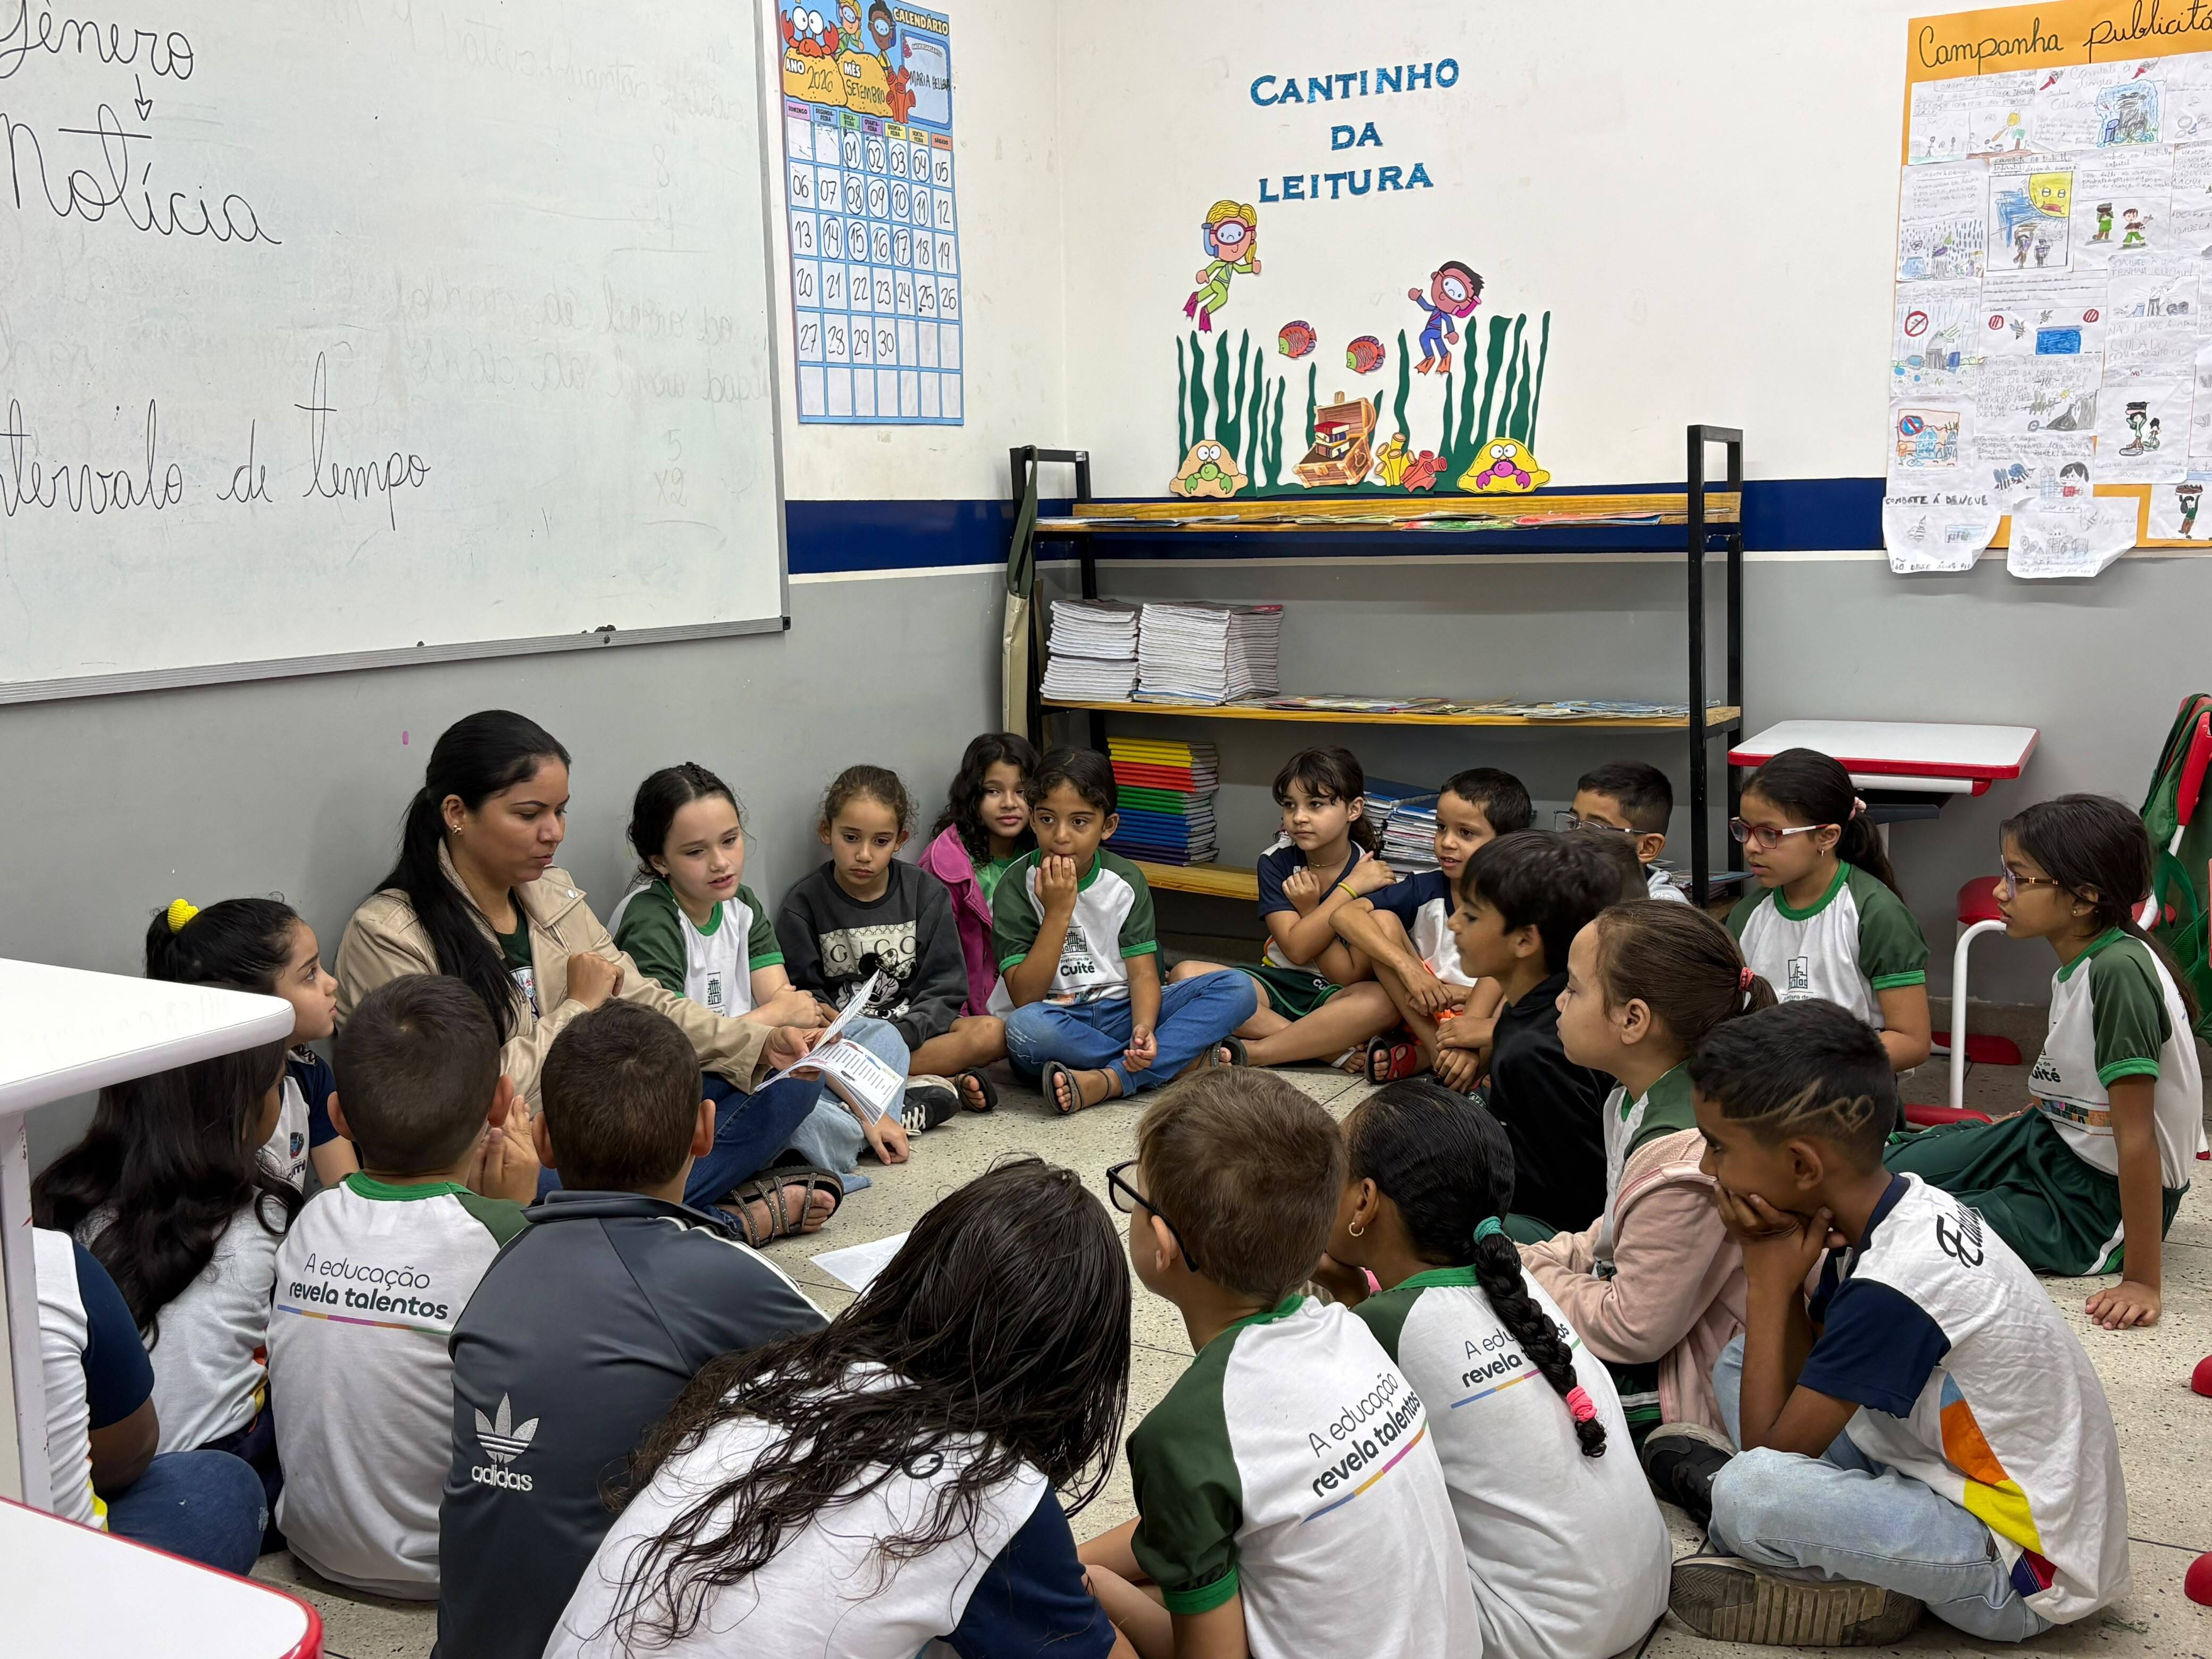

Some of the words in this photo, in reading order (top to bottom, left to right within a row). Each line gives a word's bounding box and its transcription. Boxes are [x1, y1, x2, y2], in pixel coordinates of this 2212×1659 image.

[893, 7, 949, 36] CALENDÁRIO
[785, 56, 805, 74] ANO
[1918, 18, 2064, 74] Campanha
[843, 61, 861, 78] MÊS
[1251, 58, 1459, 106] CANTINHO
[845, 79, 885, 104] SETEMBRO
[1331, 122, 1384, 150] DA
[0, 104, 282, 244] Notícia
[845, 141, 857, 164] 01
[868, 147, 883, 169] 02
[891, 151, 904, 174] 03
[914, 154, 927, 178] 04
[935, 162, 949, 182] 05
[793, 175, 809, 198] 06
[820, 180, 837, 205] 07
[847, 185, 862, 210] 08
[870, 186, 884, 215] 09
[894, 188, 906, 211] 10
[916, 197, 926, 221] 11
[937, 199, 950, 224] 12
[1259, 163, 1434, 203] LEITURA
[795, 221, 812, 249] 13
[824, 222, 839, 252] 14
[851, 227, 864, 254] 15
[874, 233, 887, 258] 16
[895, 235, 908, 263] 17
[916, 237, 929, 265] 18
[939, 241, 950, 270] 19
[797, 267, 812, 297] 20
[826, 272, 841, 299] 21
[853, 276, 868, 301] 22
[876, 280, 891, 305] 23
[898, 282, 911, 309] 24
[918, 285, 935, 309] 25
[941, 287, 957, 309] 26
[800, 323, 817, 353] 27
[827, 326, 845, 355] 28
[854, 329, 869, 357] 29
[877, 330, 894, 356] 30
[0, 398, 183, 516] tervalo
[217, 419, 273, 503] de
[295, 351, 432, 531] tempo
[1060, 961, 1095, 977] Cuité
[2032, 1066, 2062, 1083] uité
[304, 1253, 316, 1273] A
[320, 1258, 430, 1291] educação
[289, 1281, 339, 1305] revela
[345, 1287, 448, 1320] talentos
[1464, 1340, 1481, 1360] A
[1462, 1352, 1523, 1388] revela
[1308, 1432, 1333, 1458] A
[1329, 1372, 1399, 1440] educação
[1312, 1440, 1379, 1498] revela
[1373, 1391, 1421, 1447] talentos
[471, 1465, 533, 1492] adidas
